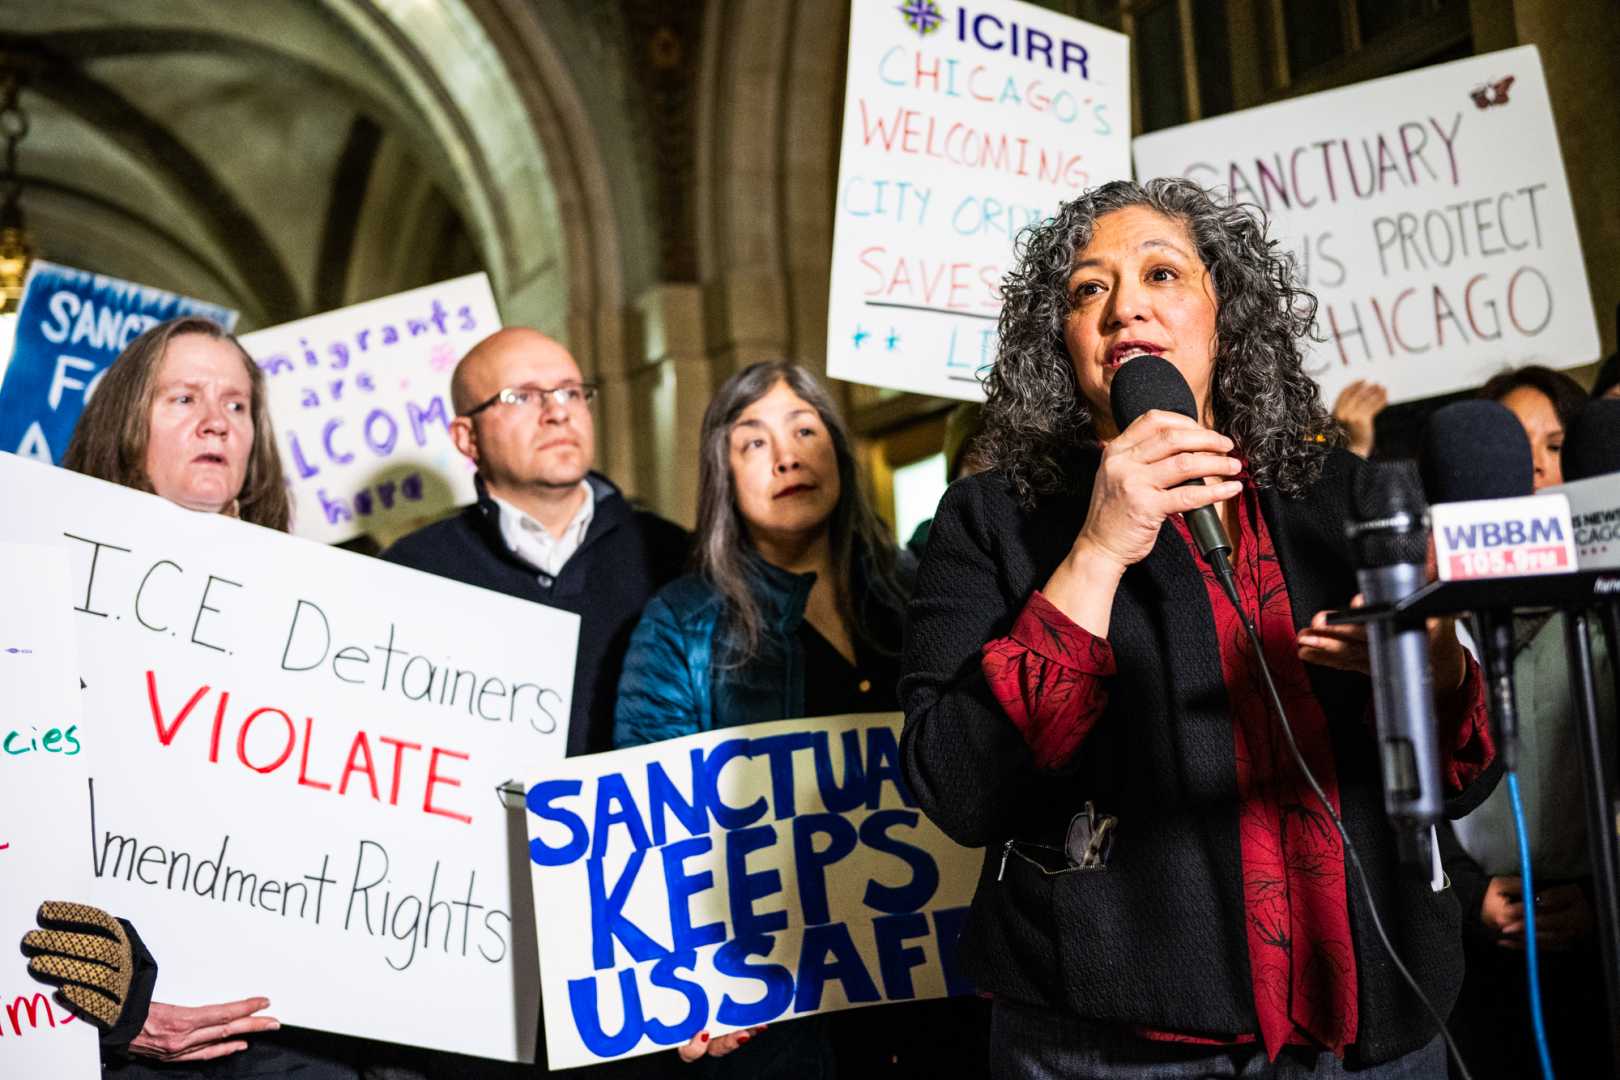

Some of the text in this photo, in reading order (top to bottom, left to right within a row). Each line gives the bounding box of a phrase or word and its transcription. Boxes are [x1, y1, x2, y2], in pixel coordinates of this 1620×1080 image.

[957, 7, 1090, 80] ICIRR
[879, 46, 1112, 137] CHICAGO'S
[859, 99, 1090, 188] WELCOMING
[842, 176, 932, 226] CITY
[1373, 183, 1547, 277] PROTECT
[858, 246, 1004, 309] SAVES
[256, 299, 477, 377] migrants
[302, 372, 376, 408] are
[316, 473, 423, 525] here
[1443, 516, 1564, 550] WBBM
[63, 533, 563, 735] I.C.E. Detainers
[2, 724, 81, 756] cies
[146, 670, 473, 824] VIOLATE
[525, 727, 919, 867] SANCTUA
[344, 840, 512, 970] Rights
[586, 809, 940, 971] KEEPS
[567, 948, 710, 1058] US
